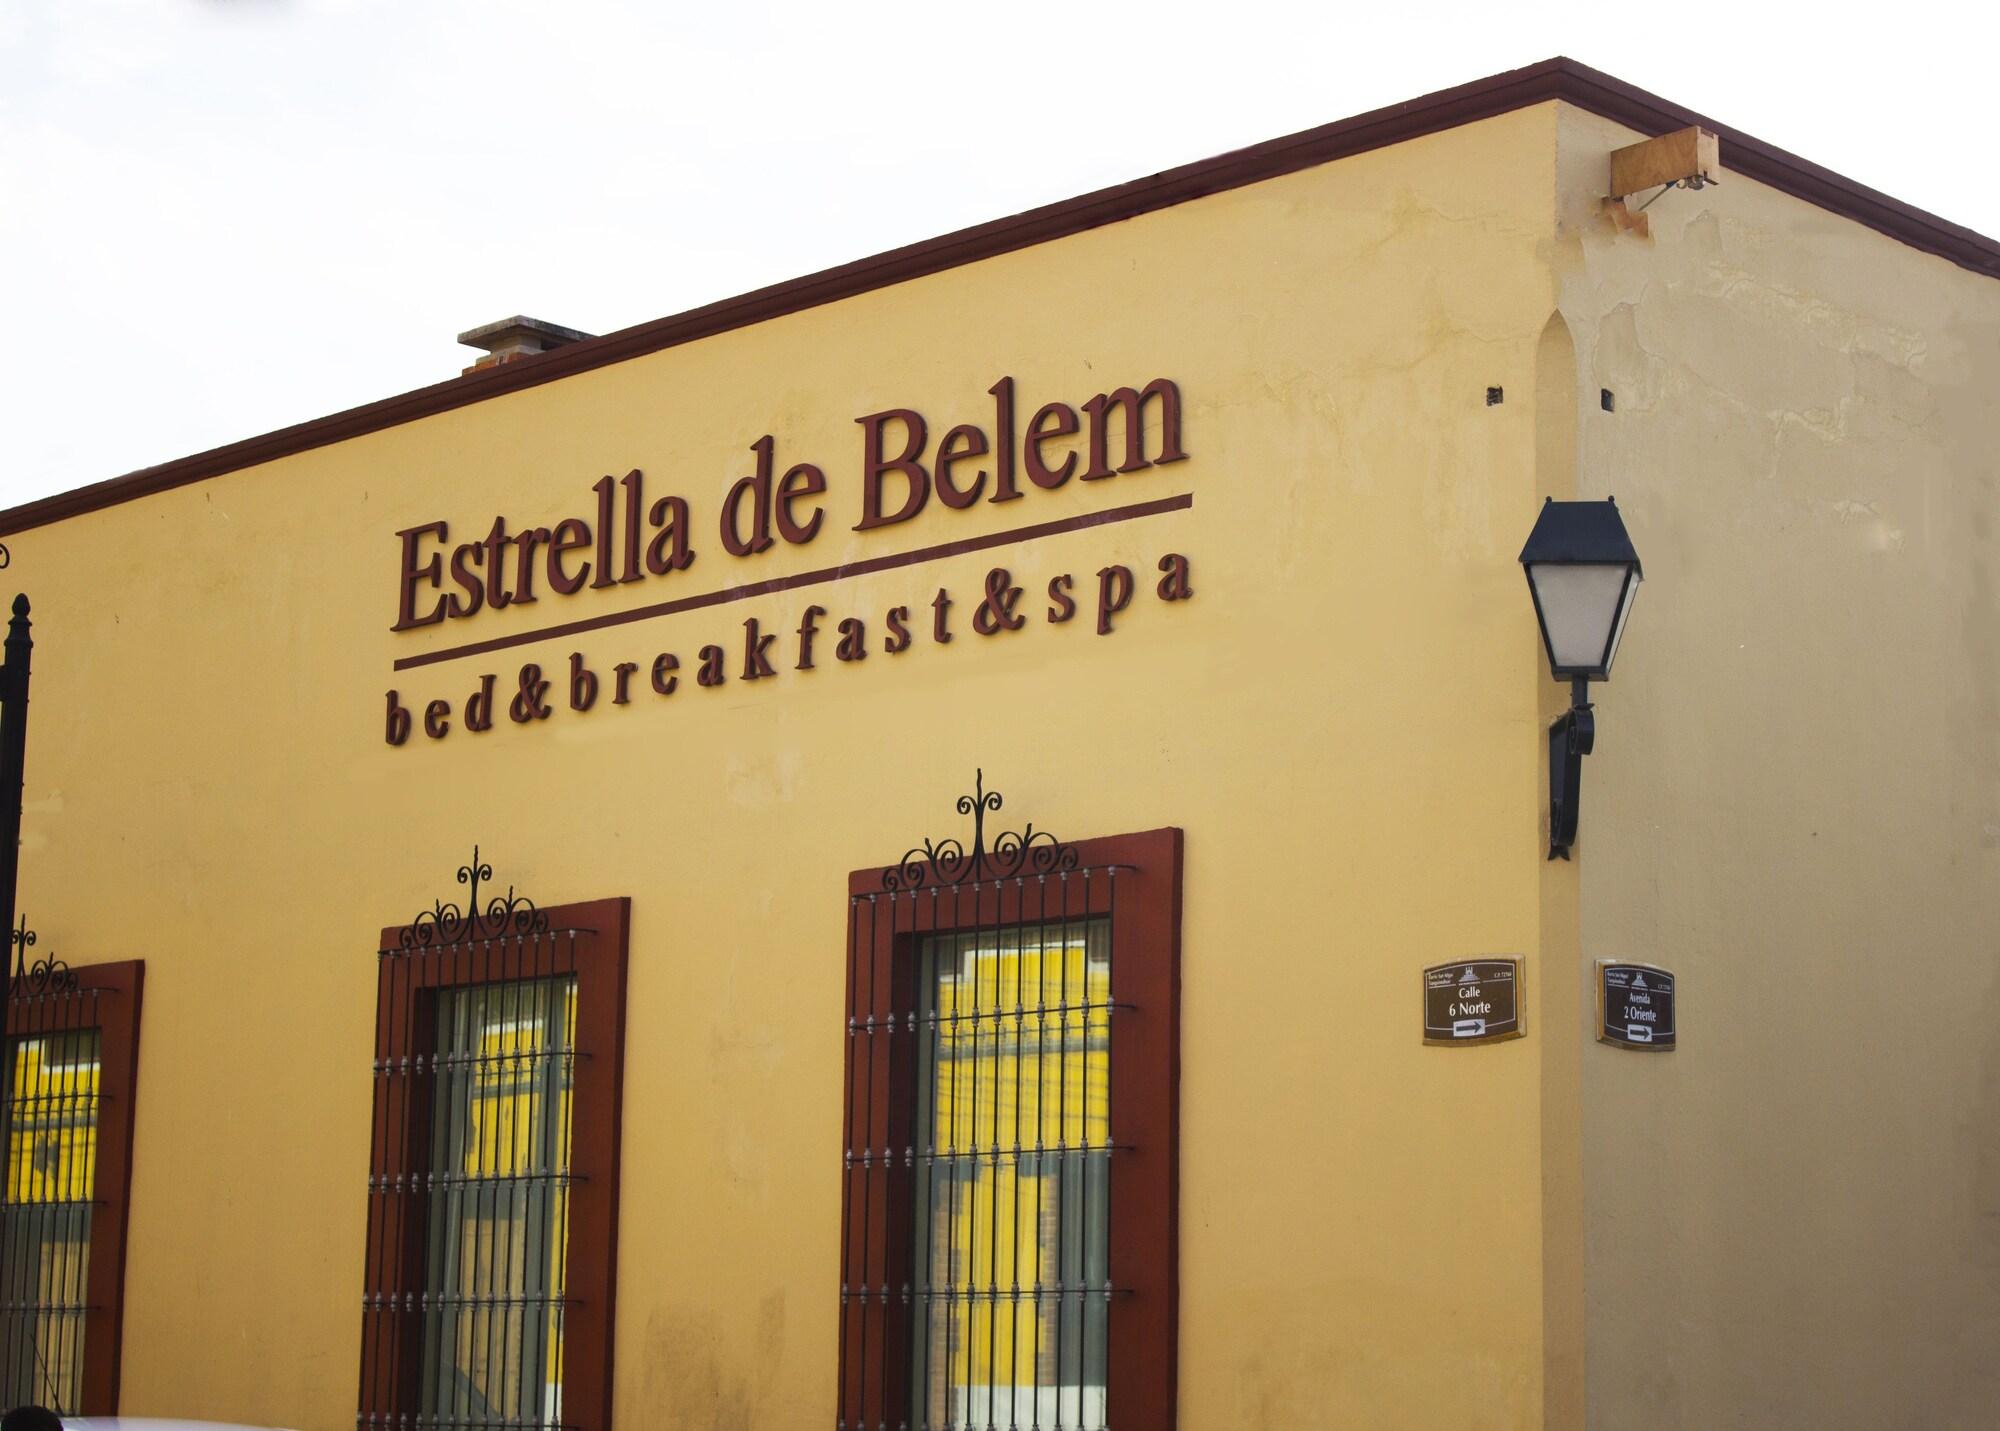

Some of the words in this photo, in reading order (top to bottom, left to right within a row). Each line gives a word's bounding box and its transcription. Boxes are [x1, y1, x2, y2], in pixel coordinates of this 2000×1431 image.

[390, 469, 695, 632] Estrella
[719, 434, 827, 556] de
[853, 375, 1190, 532] Belem
[1459, 986, 1480, 998] Calle
[1629, 992, 1650, 1004] Avenida
[1449, 1003, 1456, 1016] 6
[1459, 1001, 1491, 1016] Norte
[1624, 1006, 1629, 1019] 2
[1630, 1006, 1657, 1022] Oriente
